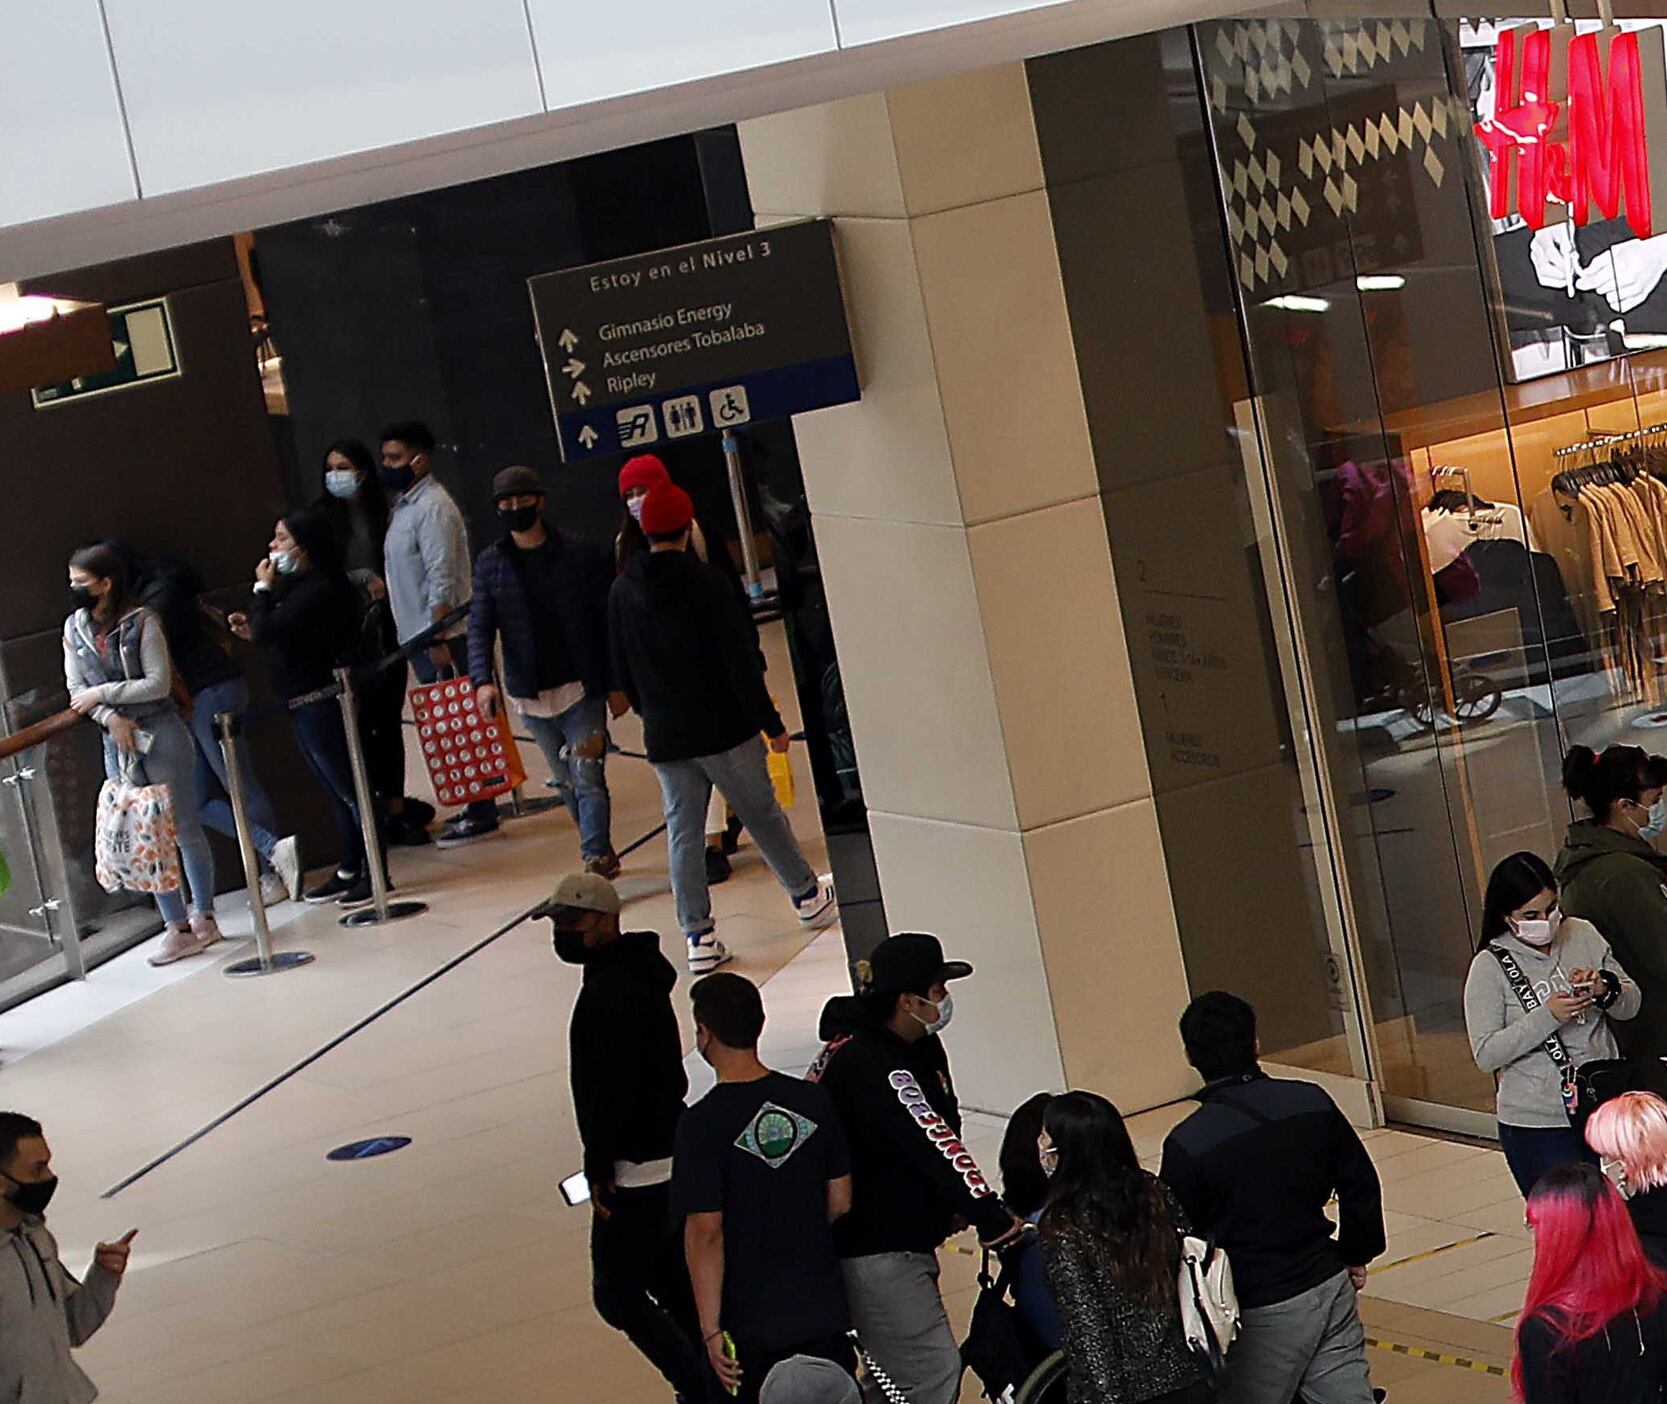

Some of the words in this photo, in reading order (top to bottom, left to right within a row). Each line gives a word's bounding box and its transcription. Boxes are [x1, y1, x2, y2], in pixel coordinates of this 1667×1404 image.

[1473, 28, 1652, 241] H&M
[590, 271, 641, 292] Estoy
[648, 264, 671, 281] en
[679, 256, 695, 273] el
[703, 245, 752, 268] Nivel
[760, 241, 771, 256] 3
[599, 315, 674, 341] Gimnasio
[677, 303, 732, 326] Energy
[603, 338, 691, 368] Ascensores
[692, 322, 766, 349] Tobalaba
[607, 371, 656, 394] Ripley
